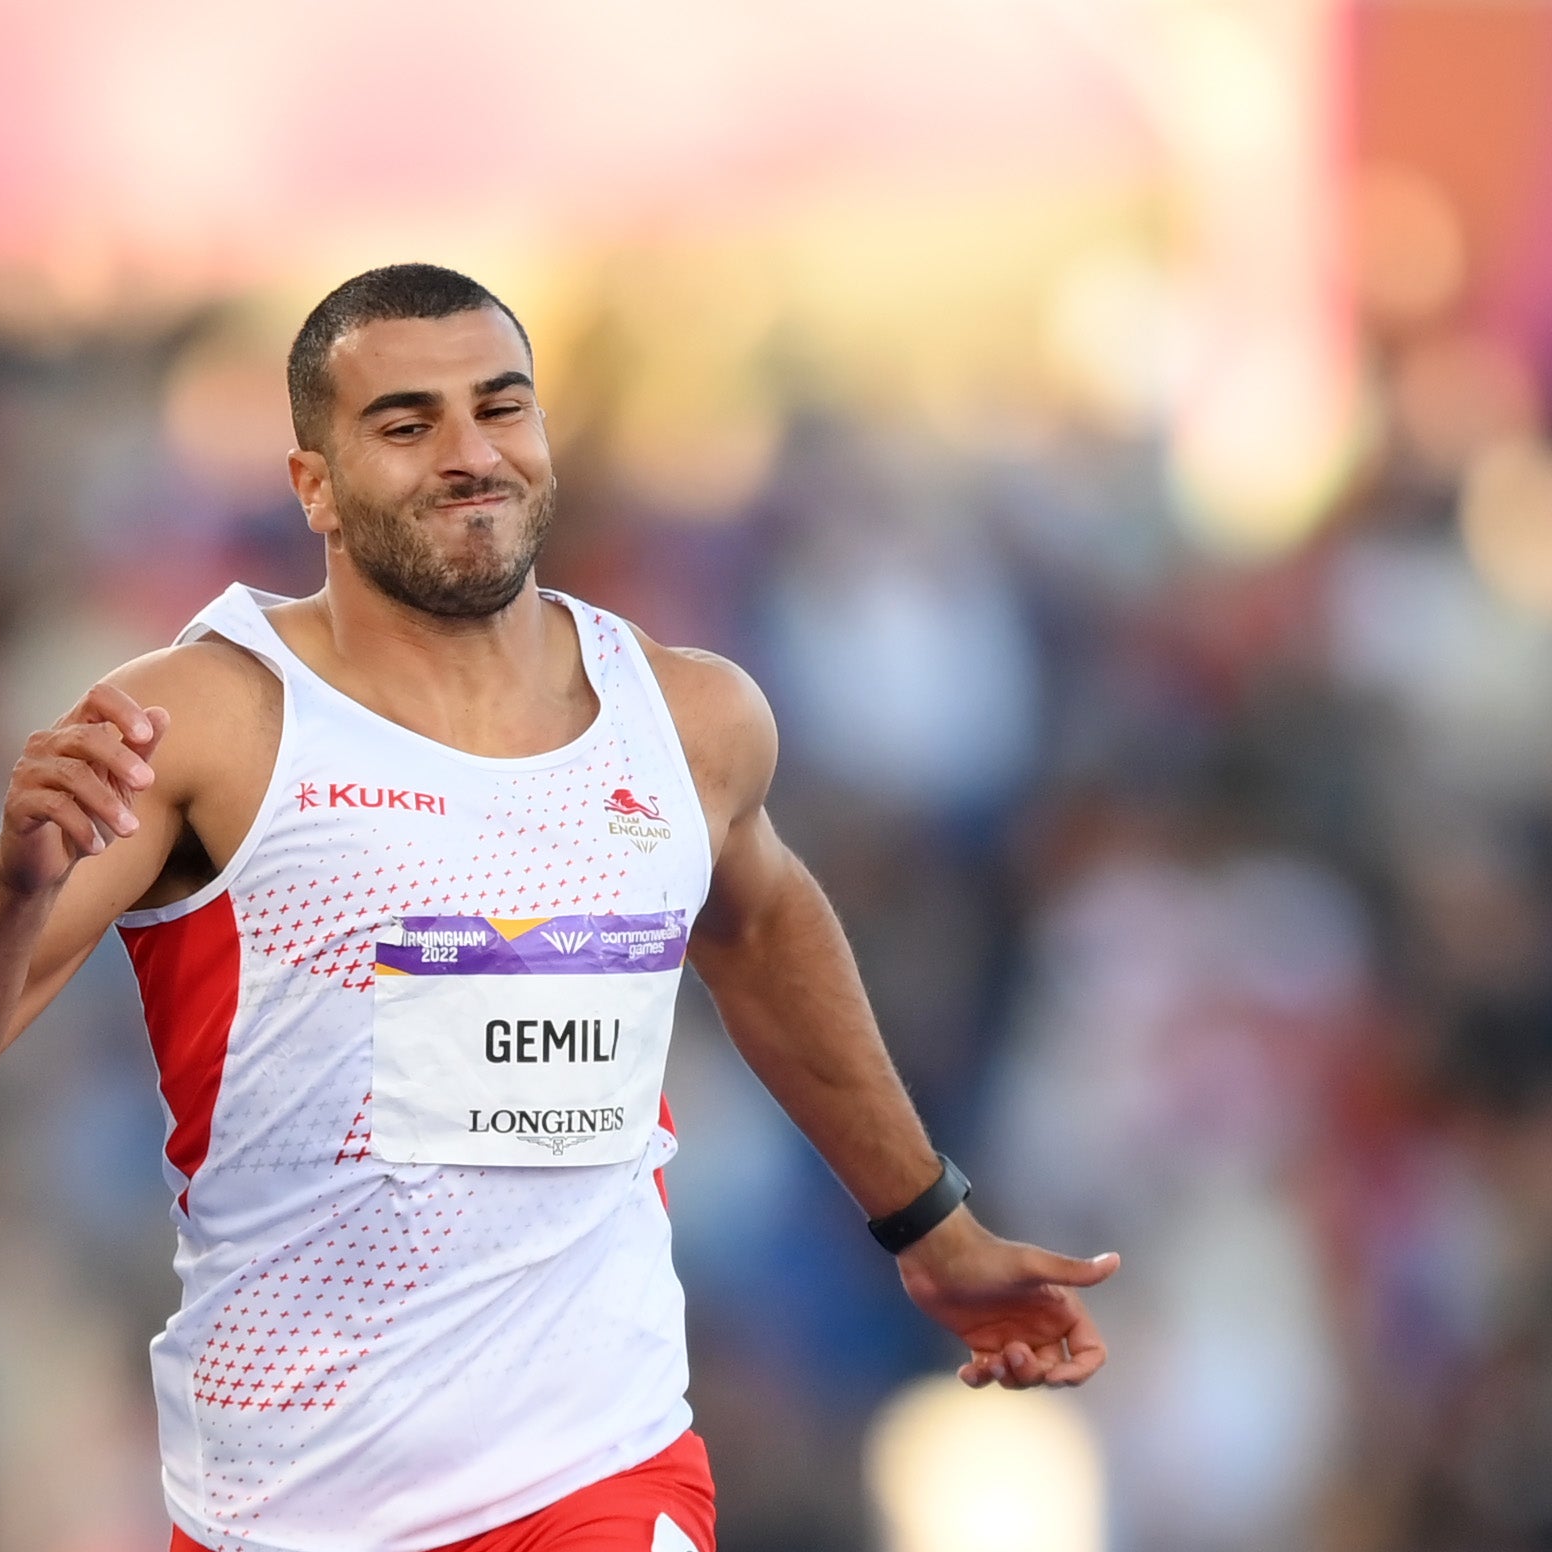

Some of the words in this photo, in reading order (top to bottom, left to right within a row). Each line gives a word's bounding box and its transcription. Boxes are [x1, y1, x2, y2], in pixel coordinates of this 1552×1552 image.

[328, 783, 446, 816] KUKRI
[608, 821, 671, 840] ENGLAND
[402, 930, 488, 947] IRMINGHAM
[421, 946, 459, 963] 2022
[628, 941, 665, 959] games
[484, 1018, 620, 1064] GEMILI
[468, 1106, 625, 1133] LONGINES
